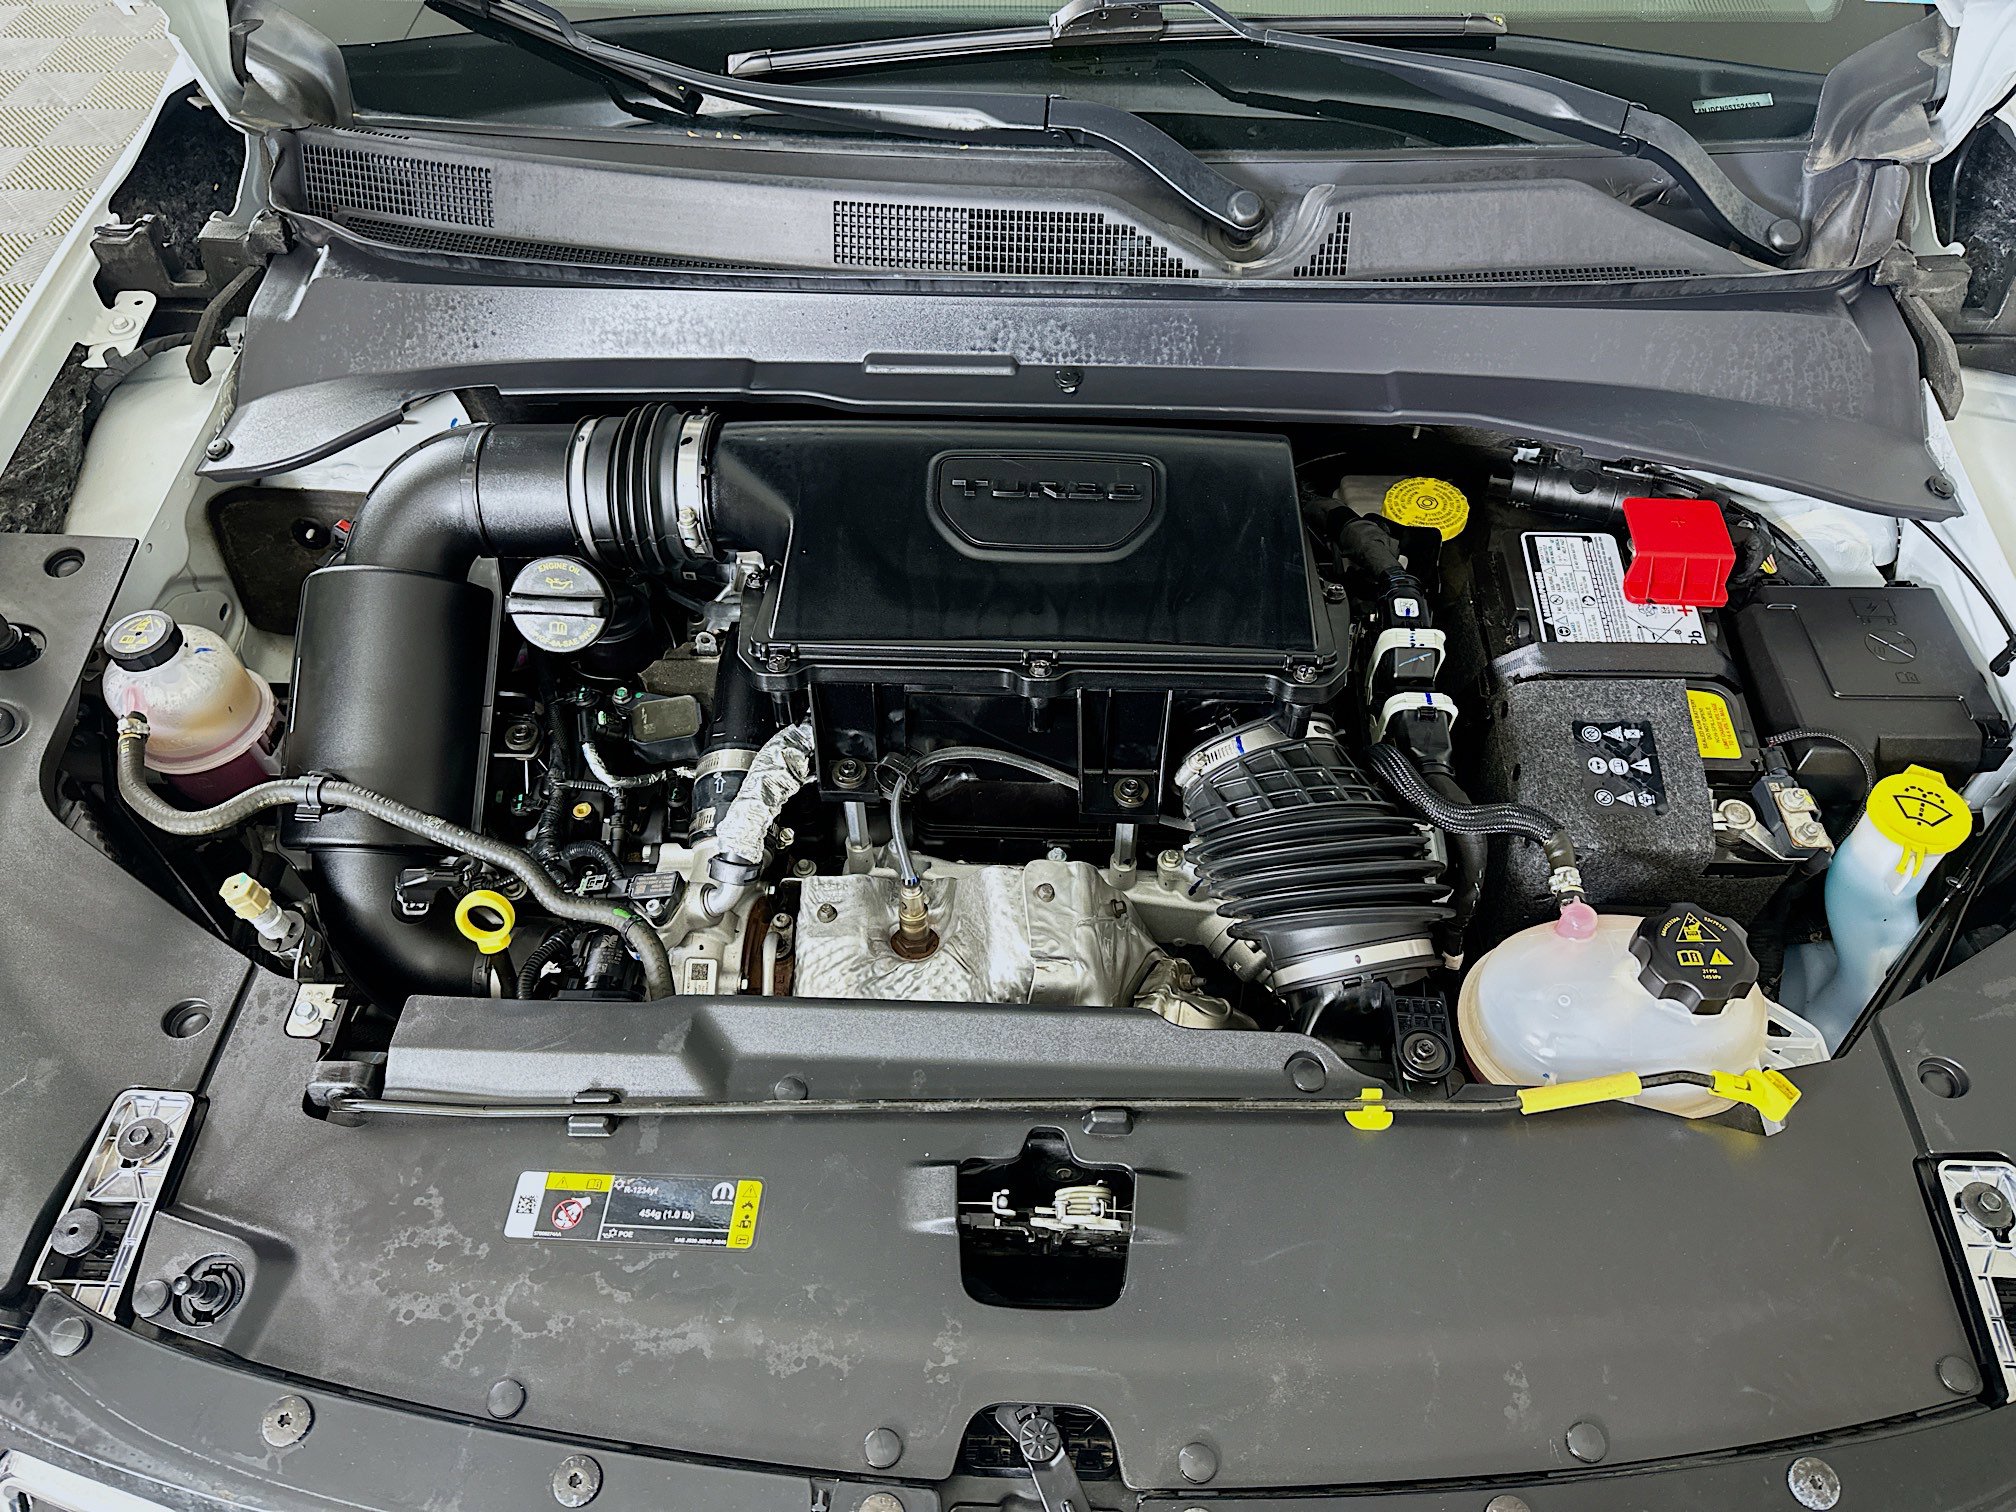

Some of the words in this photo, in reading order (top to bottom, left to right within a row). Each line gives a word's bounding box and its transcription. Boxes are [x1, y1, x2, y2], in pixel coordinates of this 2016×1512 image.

[951, 479, 1143, 499] TURBO
[538, 562, 567, 573] ENGINE
[569, 566, 581, 576] OIL
[623, 1185, 658, 1196] R-1234yf
[639, 1208, 662, 1220] 454g
[683, 1210, 694, 1221] lb)
[617, 1230, 634, 1239] POE
